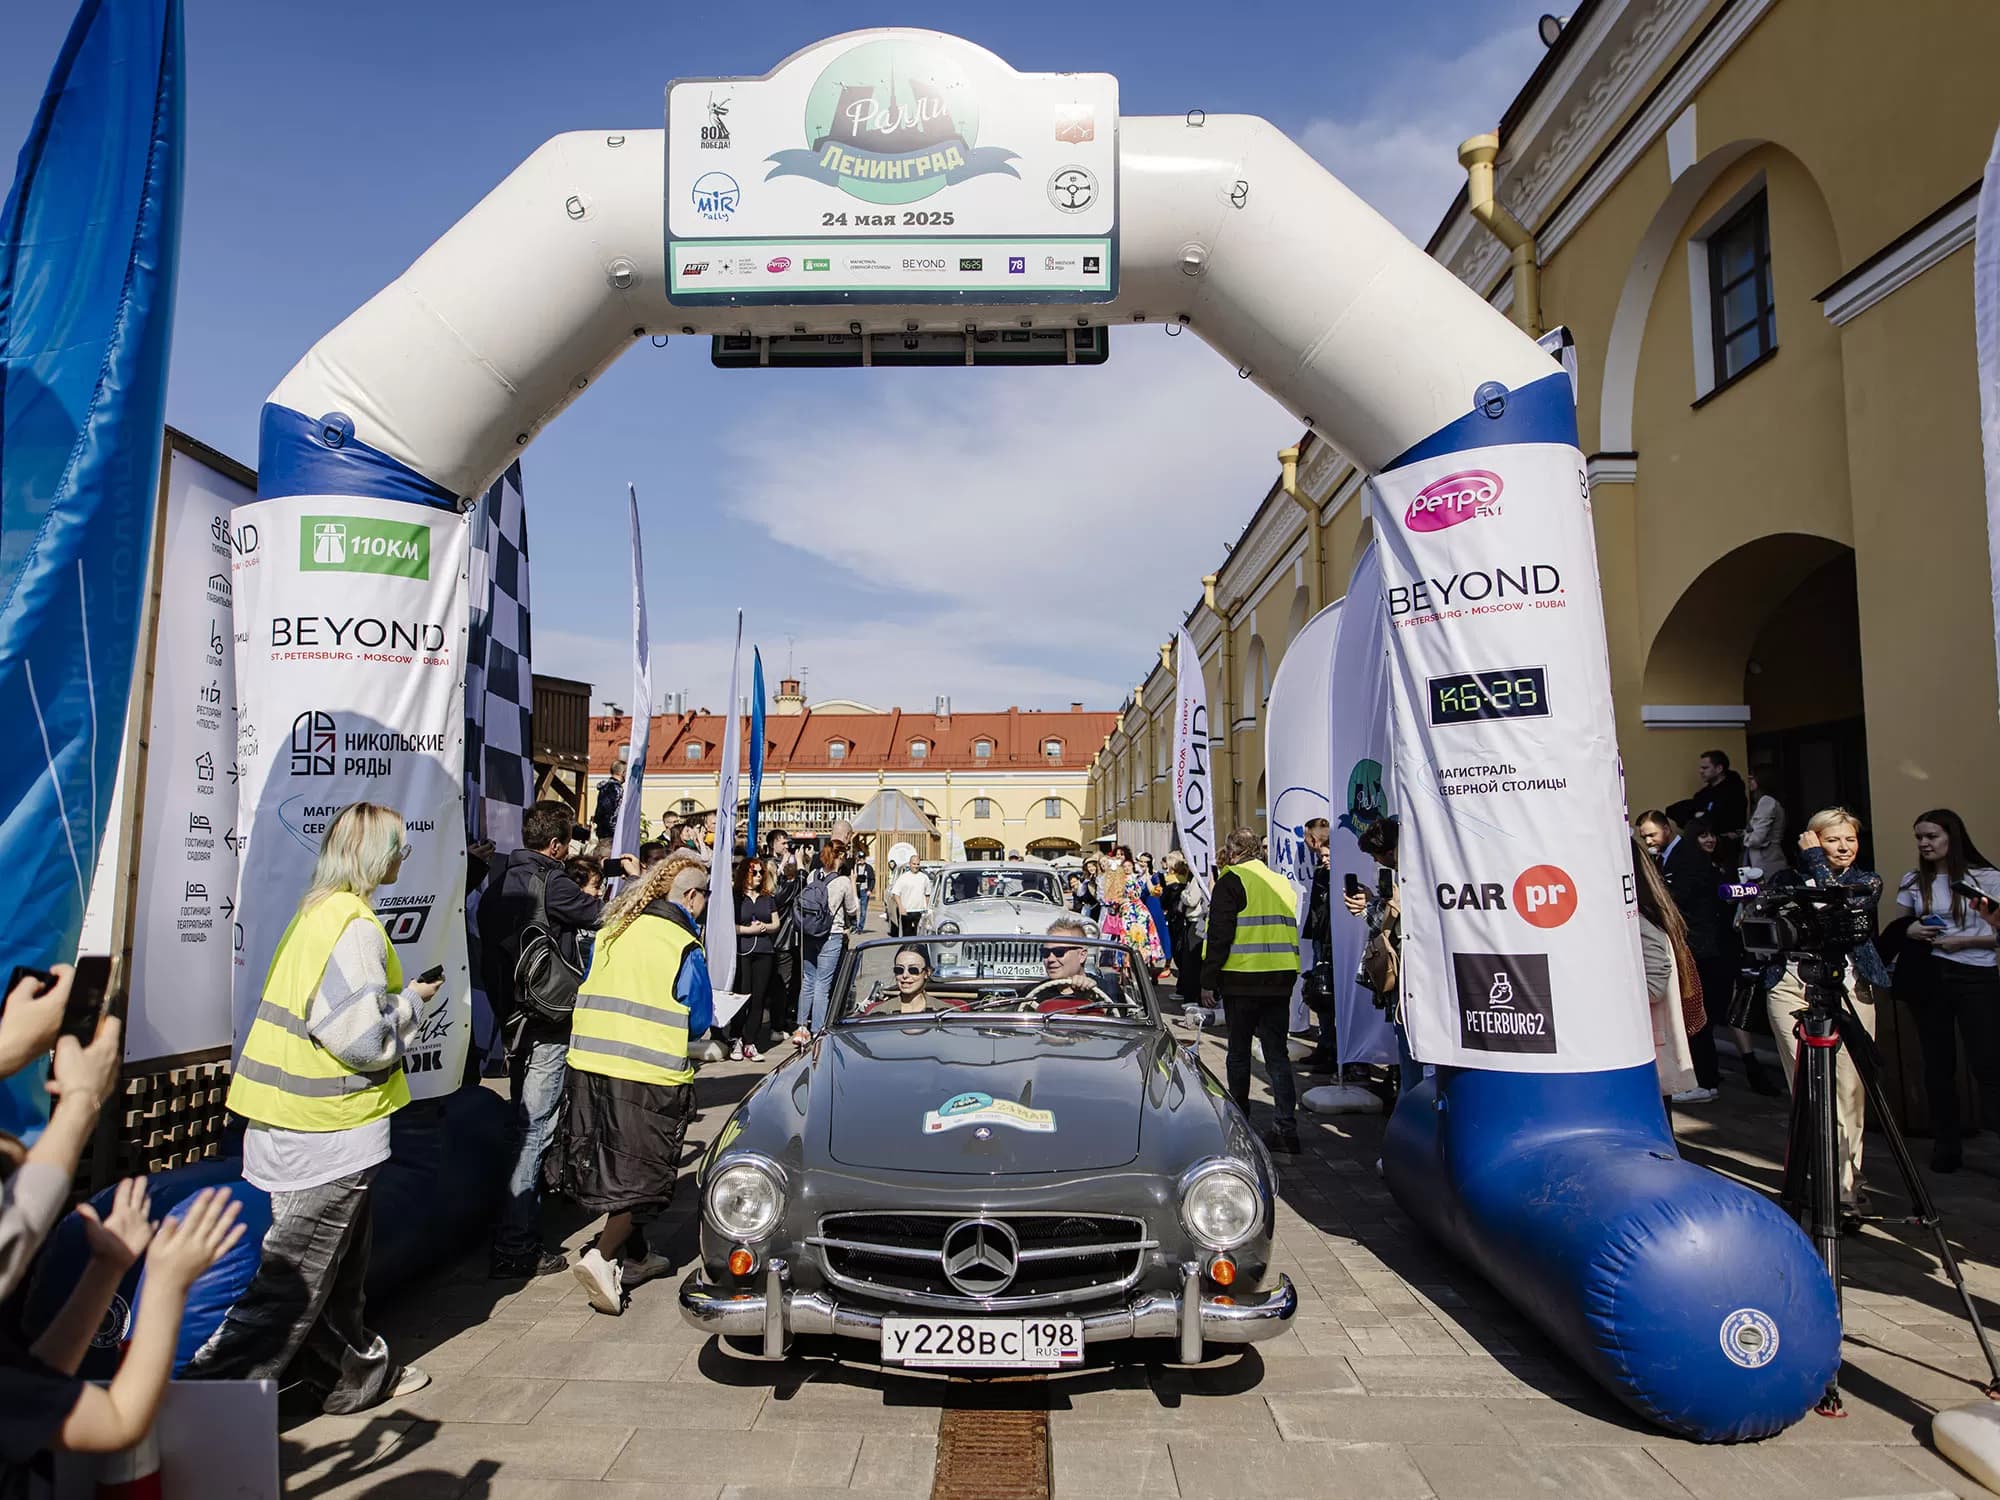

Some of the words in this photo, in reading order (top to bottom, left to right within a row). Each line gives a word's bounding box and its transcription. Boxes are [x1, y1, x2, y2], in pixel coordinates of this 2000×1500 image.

[846, 97, 949, 137] Ралли
[701, 126, 719, 140] 80
[700, 141, 731, 149] ПОБЕДА!
[819, 145, 966, 180] ЛЕНИНГРАД
[703, 212, 729, 222] rally
[822, 212, 848, 226] 24
[855, 215, 896, 226] мая
[903, 211, 955, 225] 2025
[902, 259, 946, 268] BEYOND
[1011, 259, 1023, 270] 78
[1389, 564, 1565, 617] BEYOND.
[1471, 601, 1524, 616] MOSCOW
[1535, 599, 1566, 609] DUBAI
[284, 652, 353, 661] PETERSBURG
[364, 654, 413, 664] MOSCOW
[345, 733, 445, 752] НИКОЛЬСКИЕ
[344, 758, 392, 778] РЯДЫ
[1502, 777, 1567, 793] СТОЛИЦЫ
[303, 805, 341, 817] МАГ
[758, 811, 823, 822] ИКОЛЬСКИЕ
[185, 838, 214, 849] ГОСТИНИЦА
[187, 852, 211, 861] САДОВАЯ
[1281, 866, 1314, 881] rall
[379, 894, 436, 907] ТЕЛЕКАНАЛ
[1437, 882, 1507, 911] CAR
[1525, 883, 1567, 912] pr
[181, 907, 211, 917] ГОСТИНИЦА
[177, 920, 213, 930] ТЕАТРАЛЬНАЯ
[181, 933, 207, 944] ПЛОЩАДЬ
[1466, 1010, 1545, 1035] PETERBURG2
[894, 1324, 1018, 1355] У228ВС
[1027, 1323, 1074, 1347] 198
[1036, 1347, 1060, 1357] RUS
